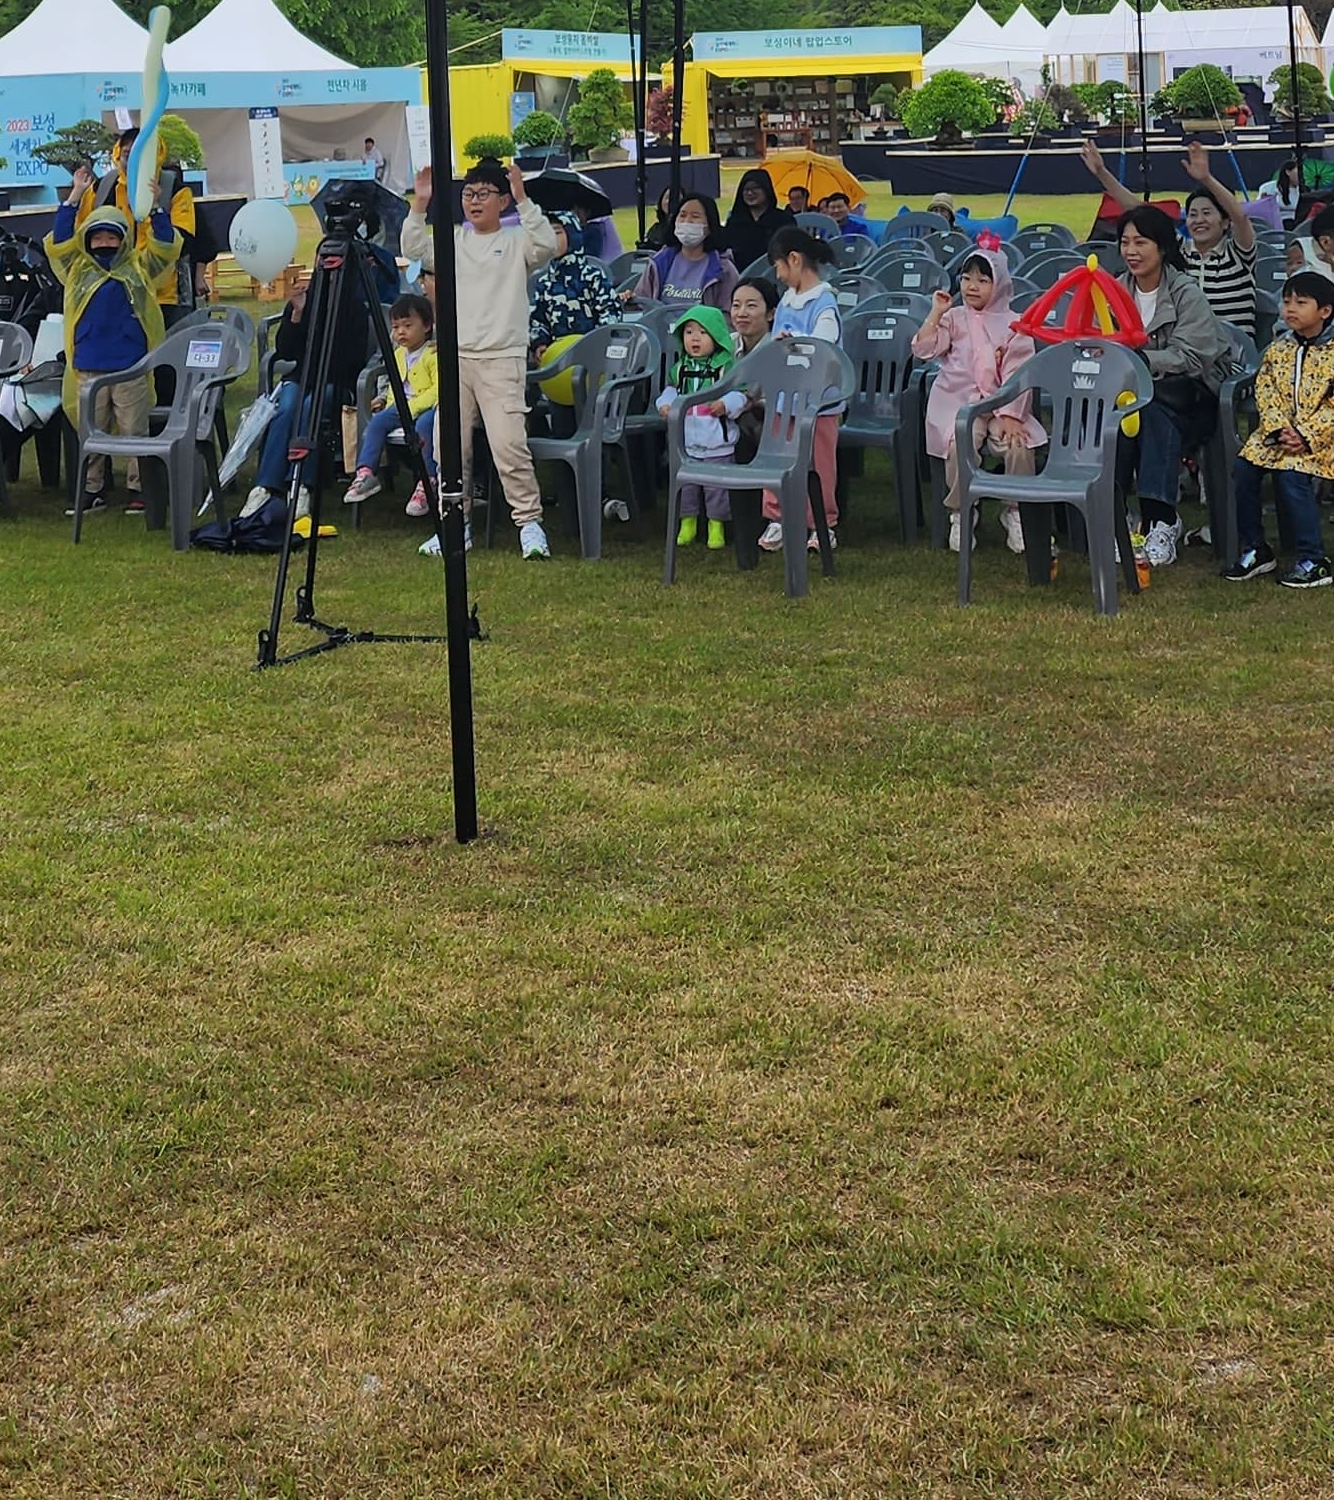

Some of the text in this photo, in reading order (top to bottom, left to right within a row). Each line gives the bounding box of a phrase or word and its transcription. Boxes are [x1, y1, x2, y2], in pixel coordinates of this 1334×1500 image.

[6, 112, 56, 134] 2023 보성
[16, 159, 50, 177] EXPO
